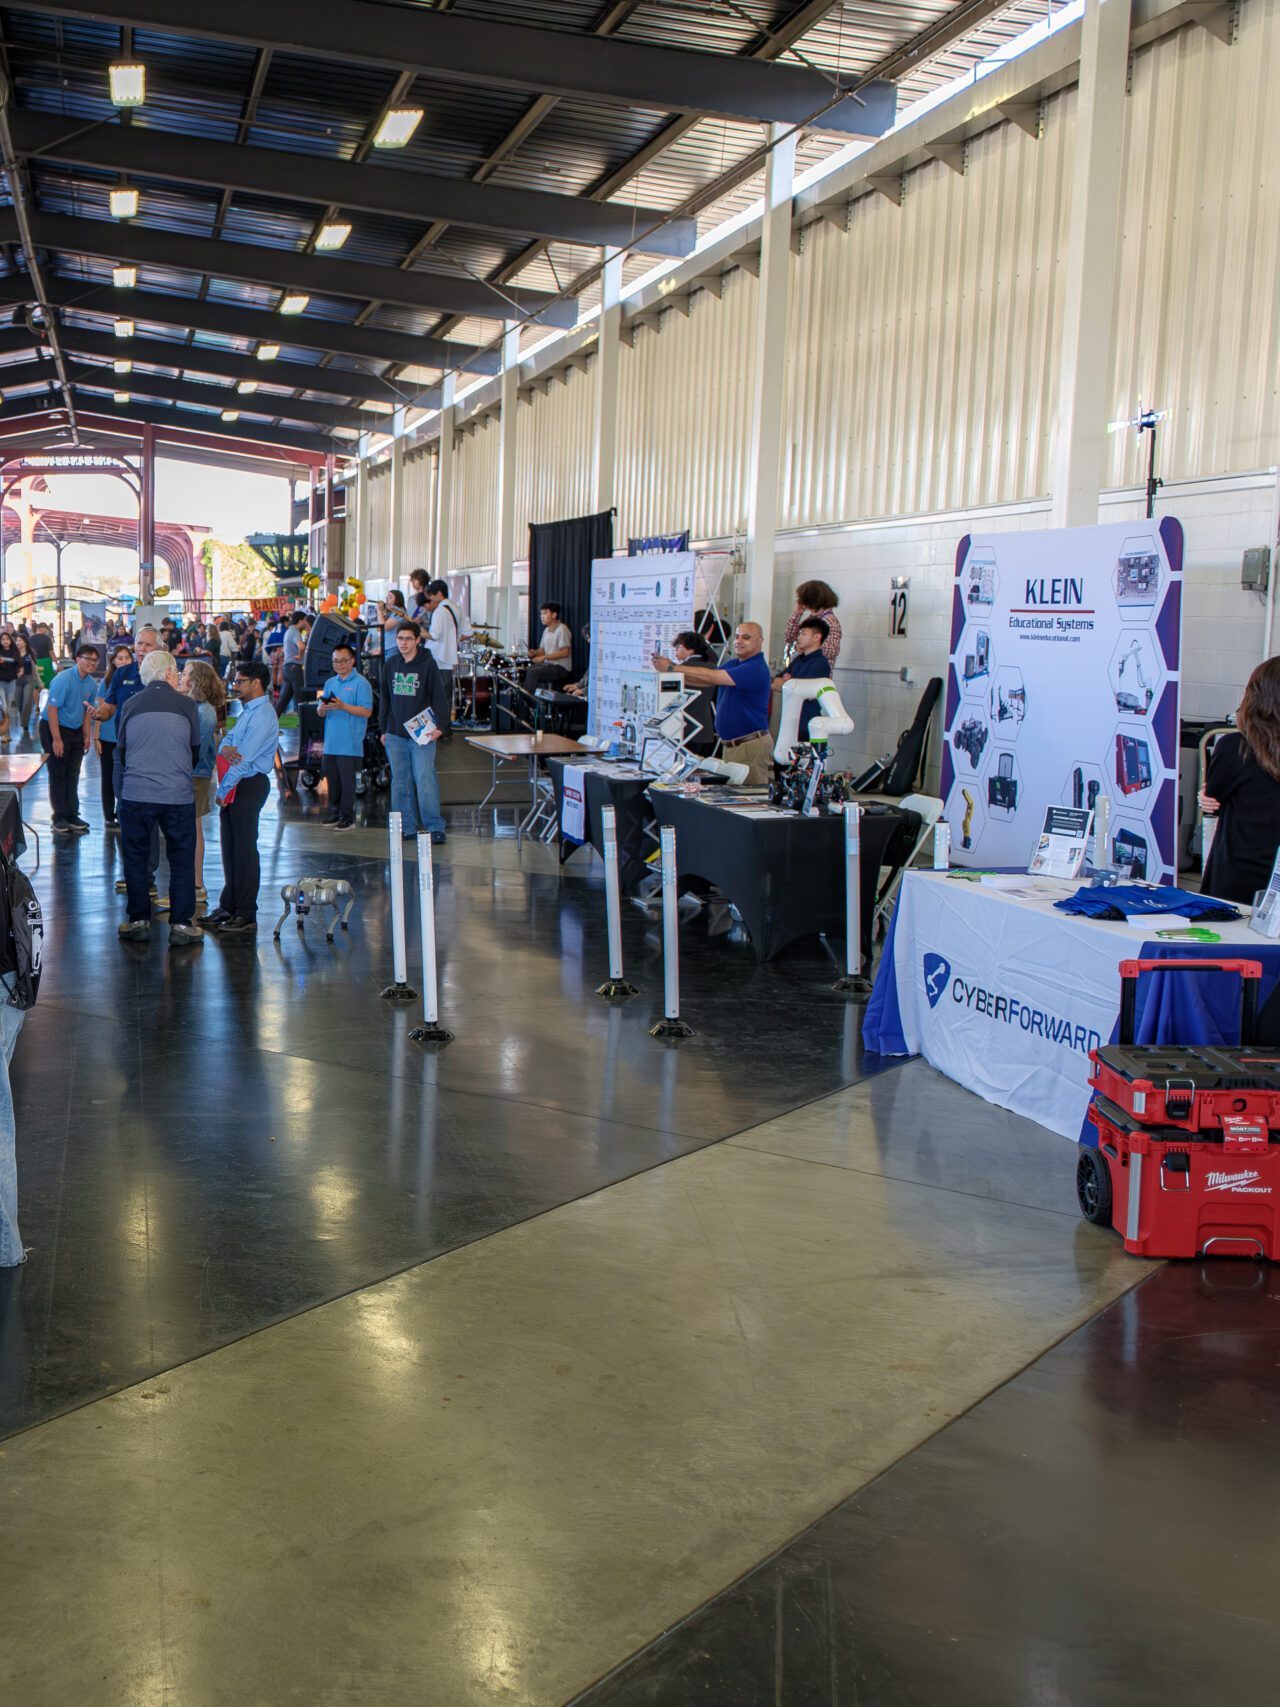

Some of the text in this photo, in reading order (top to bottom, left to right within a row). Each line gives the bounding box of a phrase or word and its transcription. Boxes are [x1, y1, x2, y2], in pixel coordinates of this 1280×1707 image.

[1025, 578, 1083, 605] KLEIN
[891, 592, 906, 635] 12
[1009, 617, 1094, 632] Educational Systems
[1019, 634, 1081, 642] www.kleineducational.com
[952, 977, 1101, 1054] CYBERFORWARD
[1205, 1169, 1261, 1187] Milwaukee
